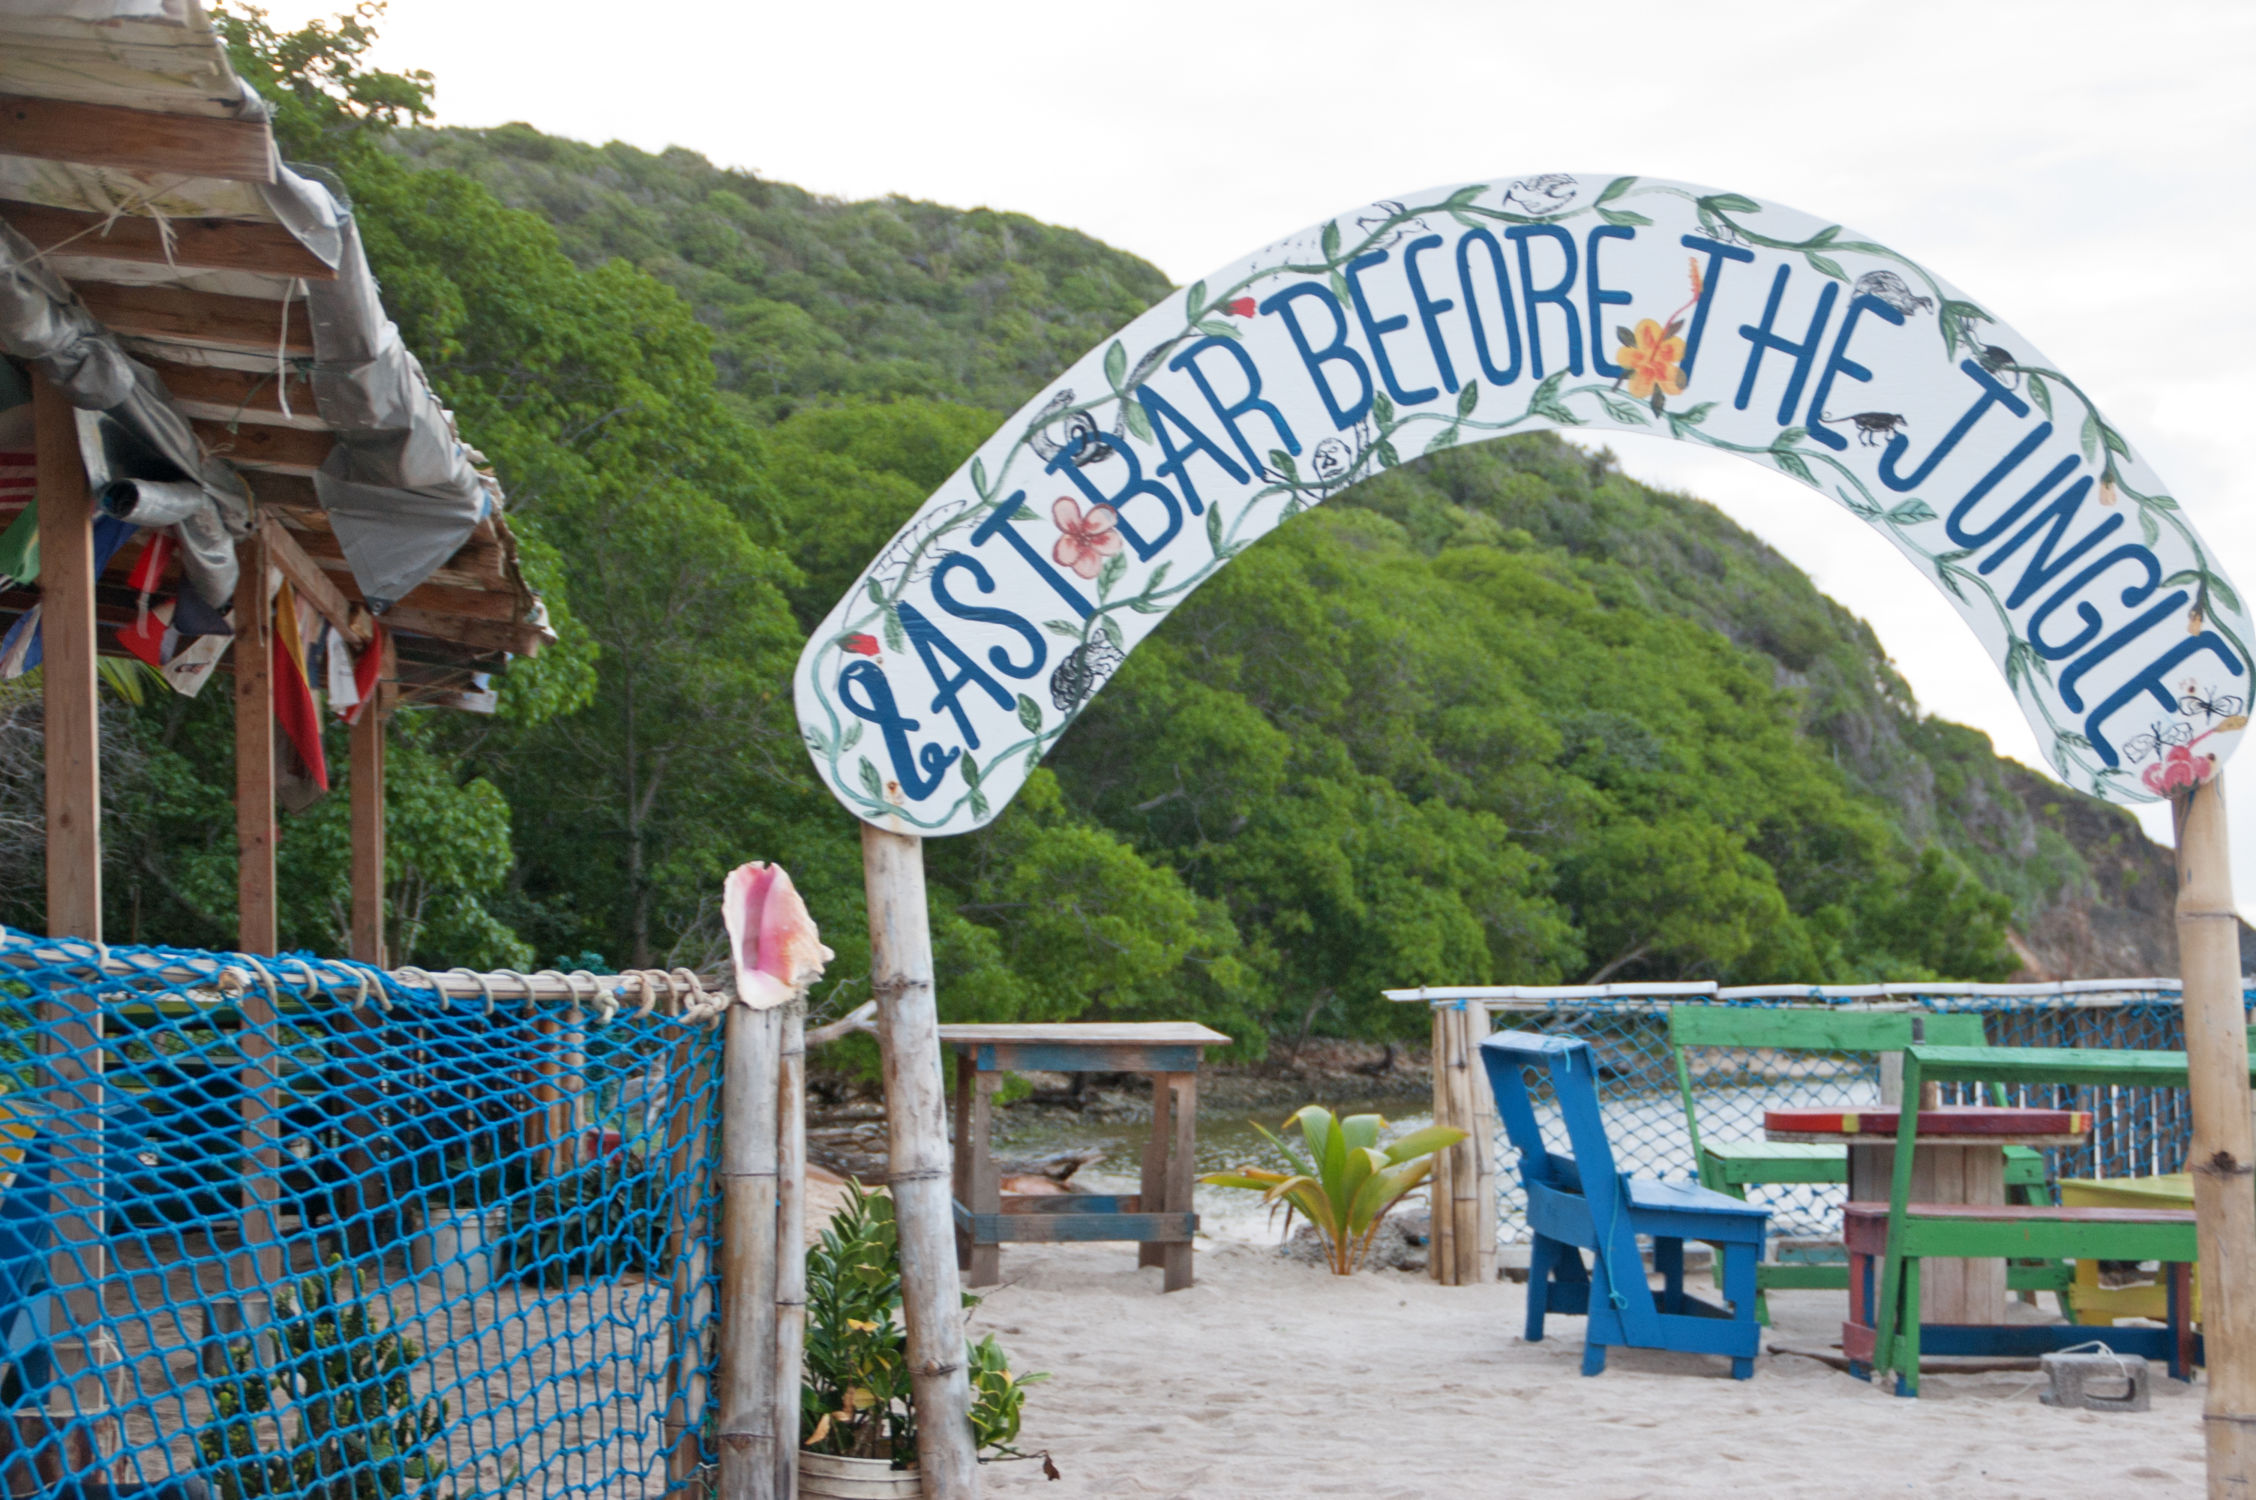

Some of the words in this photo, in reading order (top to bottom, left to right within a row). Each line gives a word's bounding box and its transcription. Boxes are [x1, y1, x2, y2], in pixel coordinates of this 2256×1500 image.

[838, 490, 1098, 801] LAST
[1046, 336, 1301, 562] BAR
[1259, 224, 1637, 430] BEFORE
[1680, 235, 1905, 451] THE
[1878, 359, 2244, 767] JUNGLE
